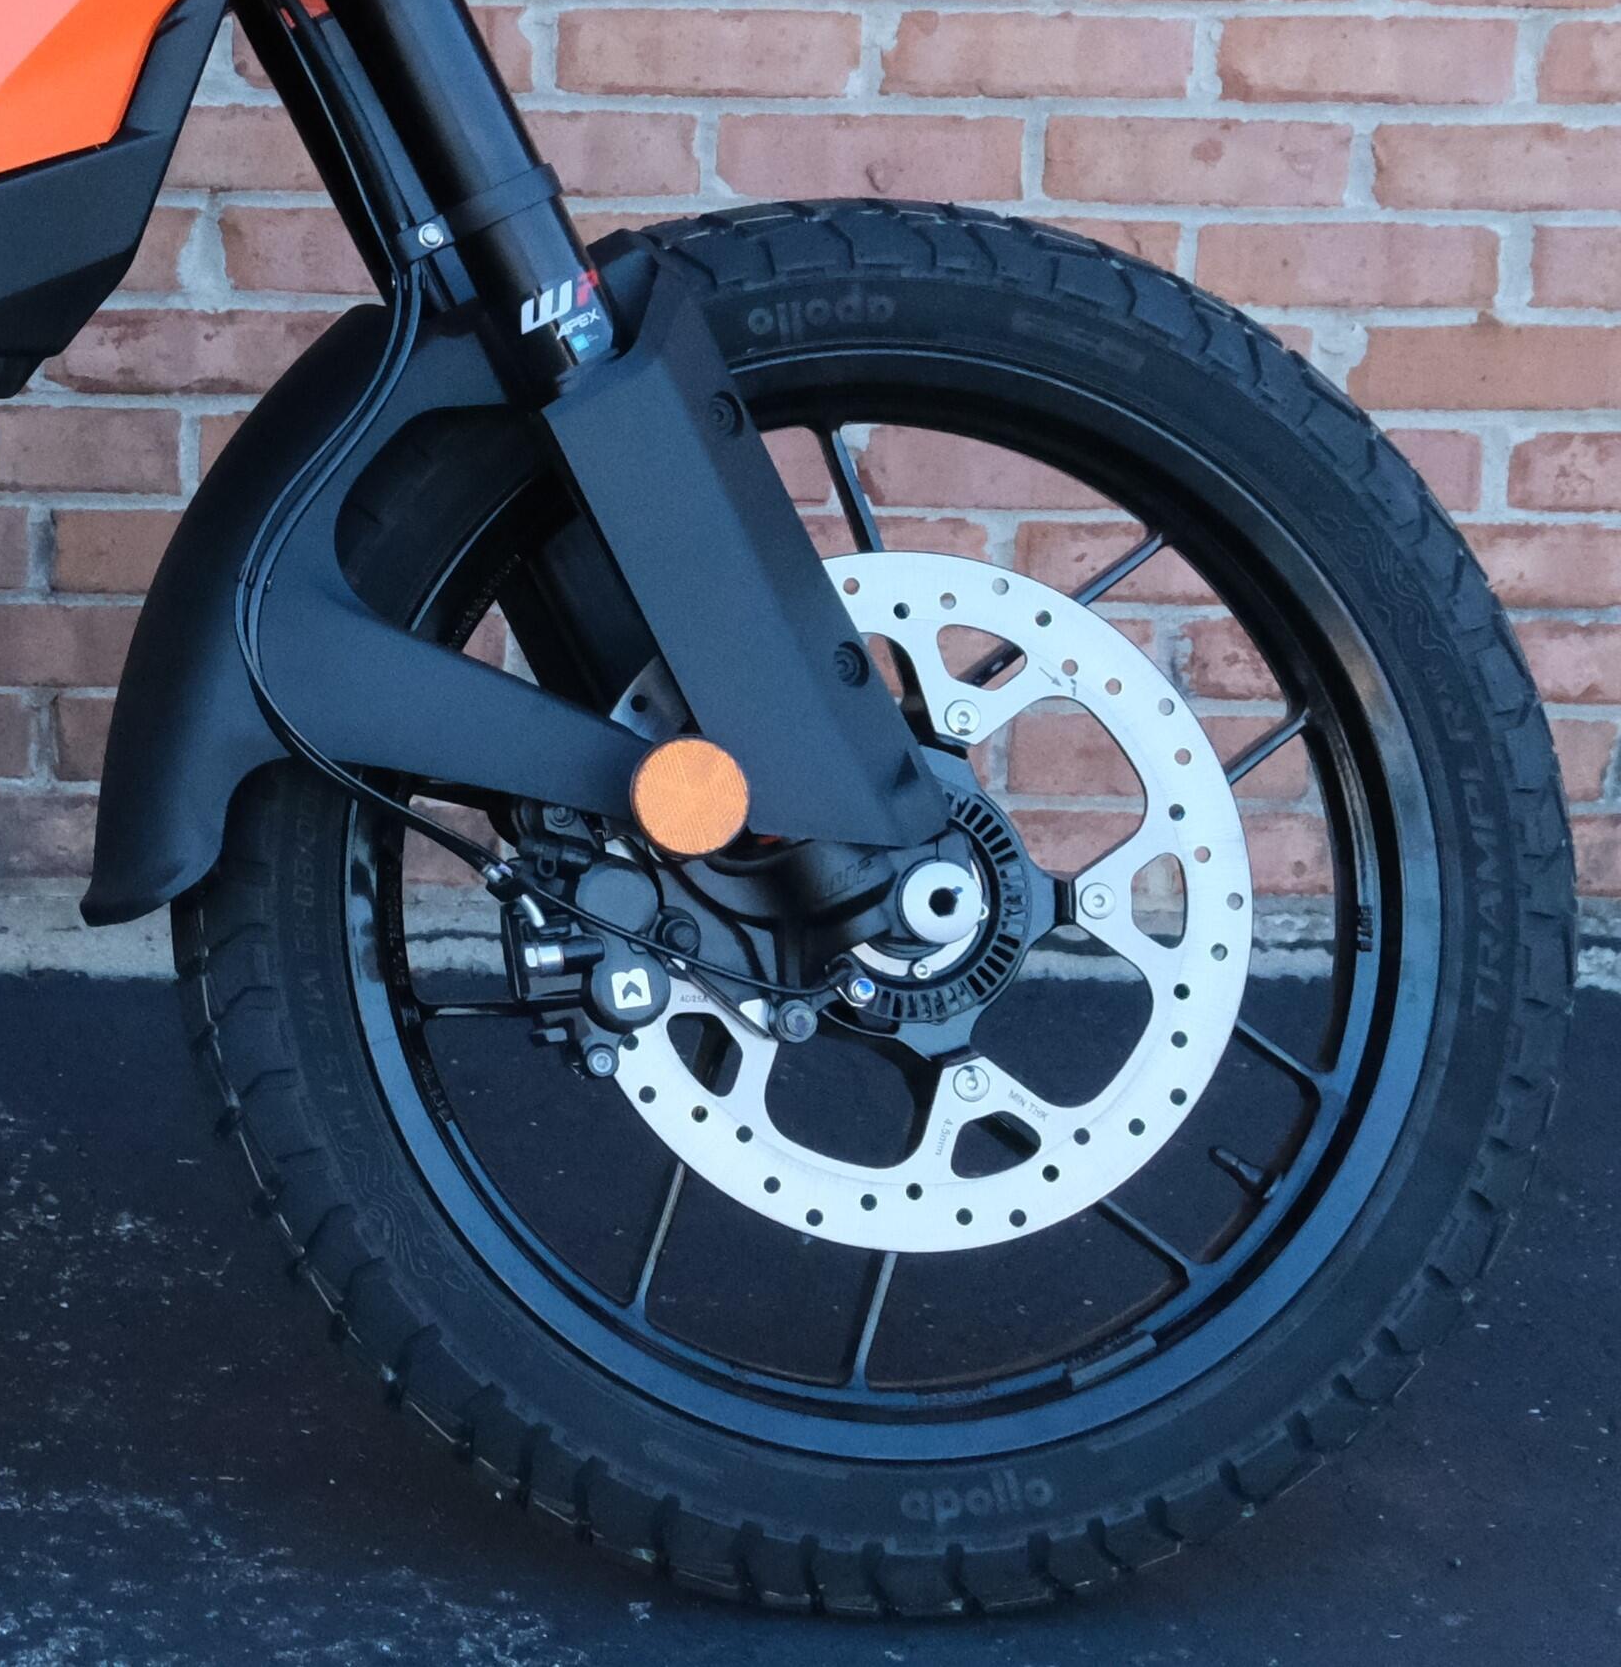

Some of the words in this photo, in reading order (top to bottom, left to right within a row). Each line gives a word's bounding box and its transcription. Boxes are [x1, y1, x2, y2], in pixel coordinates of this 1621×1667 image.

[557, 309, 601, 341] APEX
[746, 287, 898, 342] apollo
[898, 1468, 1057, 1527] apollo
